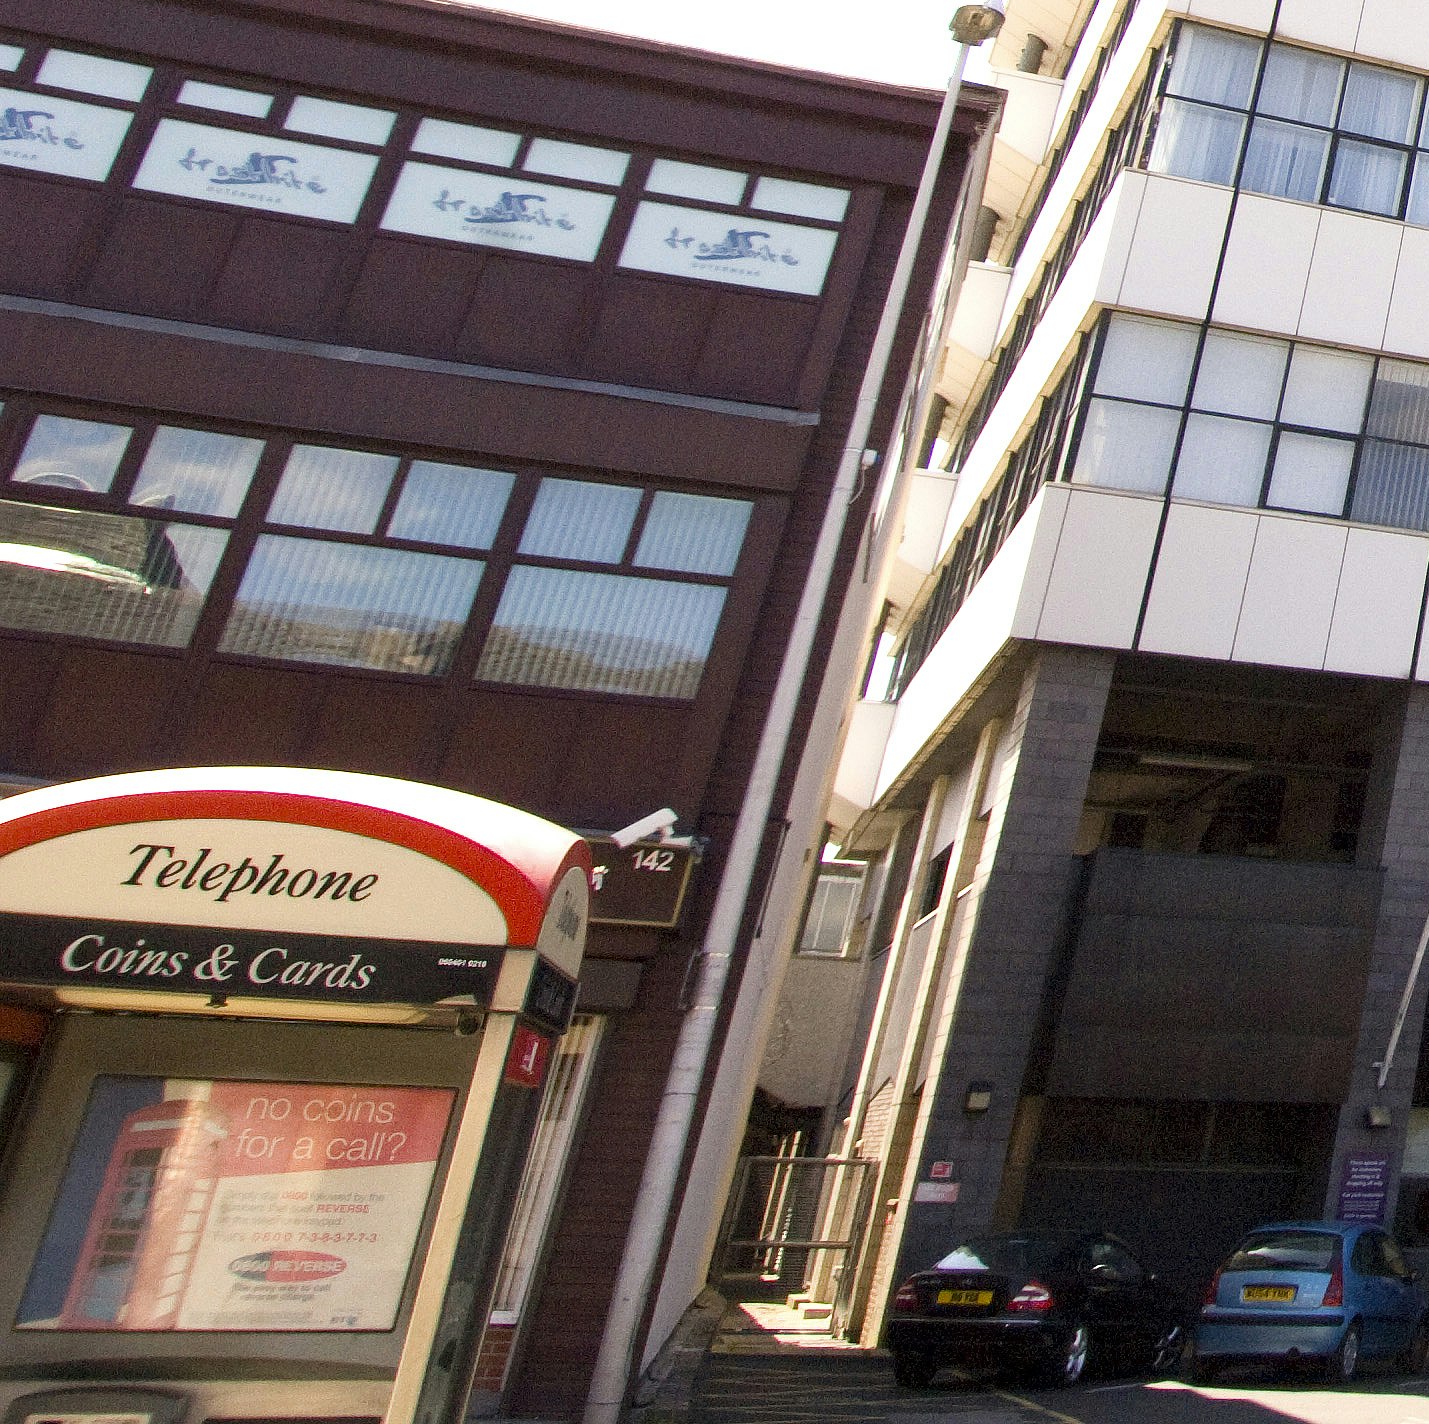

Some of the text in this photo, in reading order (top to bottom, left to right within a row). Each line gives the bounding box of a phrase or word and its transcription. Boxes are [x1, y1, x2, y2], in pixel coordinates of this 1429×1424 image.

[119, 843, 379, 903] Telephone
[632, 850, 674, 872] 142
[60, 933, 377, 990] Coins & Cards
[246, 1093, 395, 1124] no coins
[235, 1128, 407, 1162] for a call?
[315, 1204, 370, 1213] REVERSE
